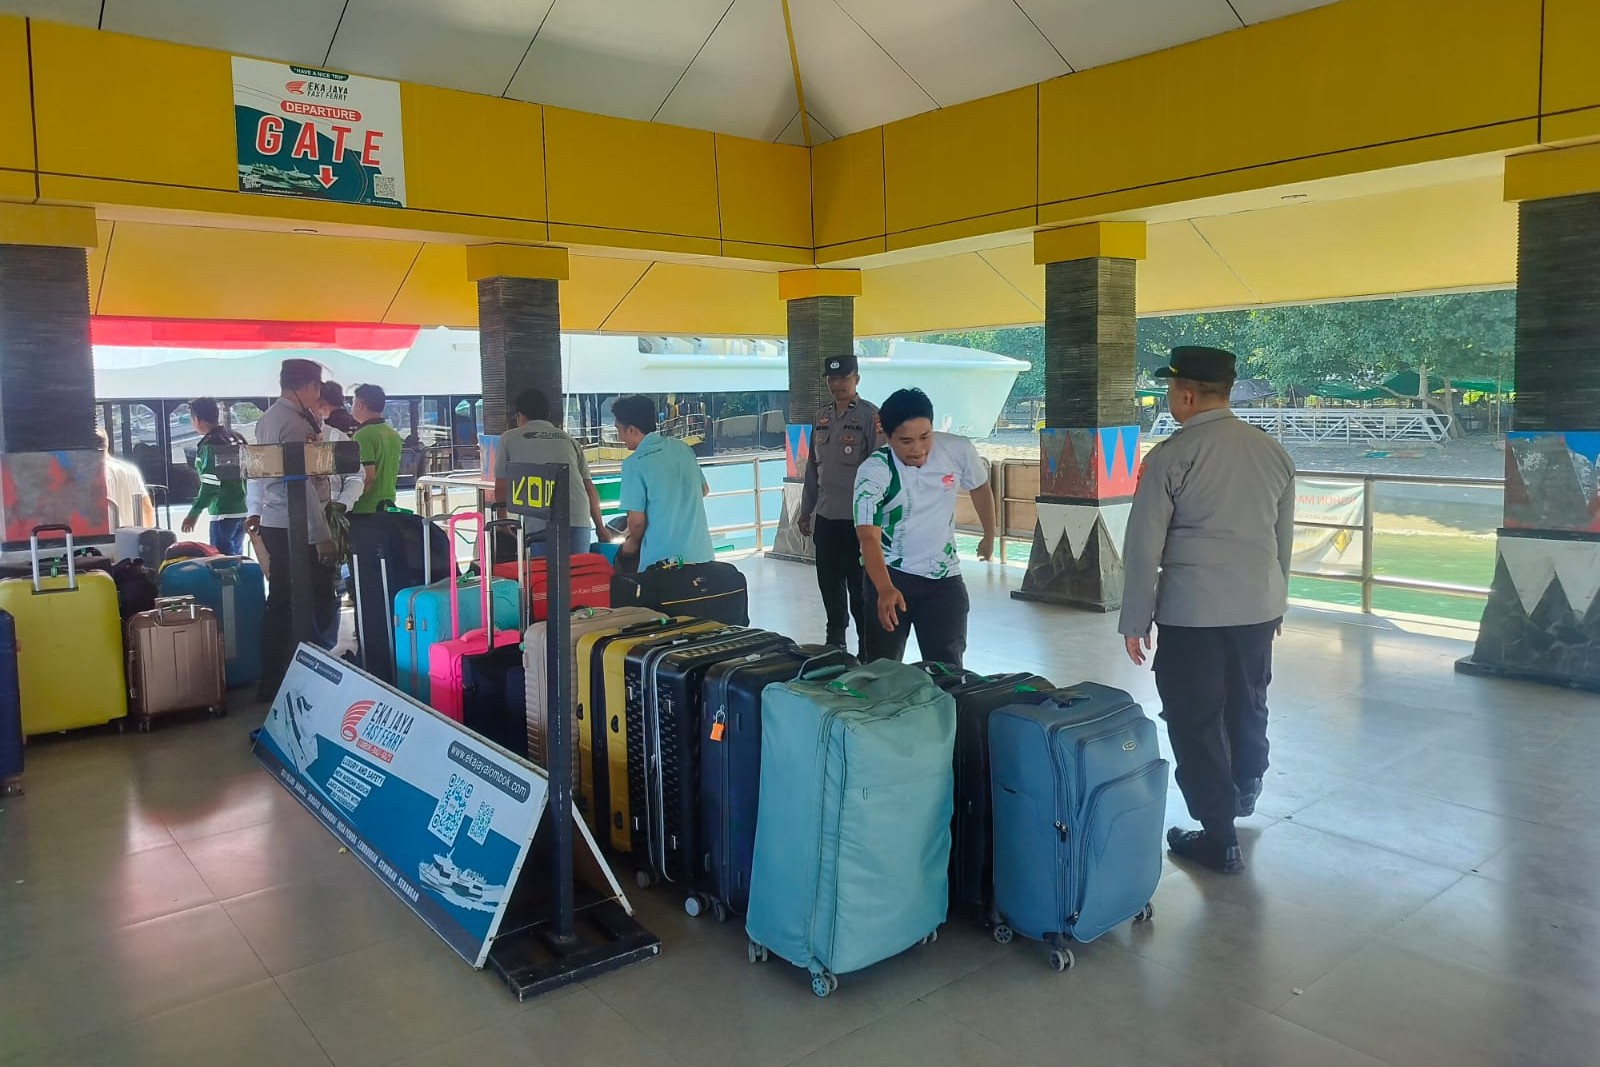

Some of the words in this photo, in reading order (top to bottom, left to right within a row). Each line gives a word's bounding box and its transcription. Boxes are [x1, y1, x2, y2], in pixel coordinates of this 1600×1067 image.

[307, 89, 323, 98] FAST
[326, 92, 347, 101] FERRY
[308, 82, 325, 92] EKA
[329, 84, 348, 94] JAYA
[286, 102, 356, 121] DEPARTURE
[256, 115, 384, 166] GATE
[370, 702, 391, 730] EKA
[388, 712, 415, 735] JAYA
[362, 722, 384, 742] FAST
[379, 730, 407, 752] FERRY
[342, 757, 359, 773] LUXURY
[358, 766, 368, 776] AND
[367, 770, 385, 786] SAFETY
[450, 745, 527, 798] www.ekajayalombok.com
